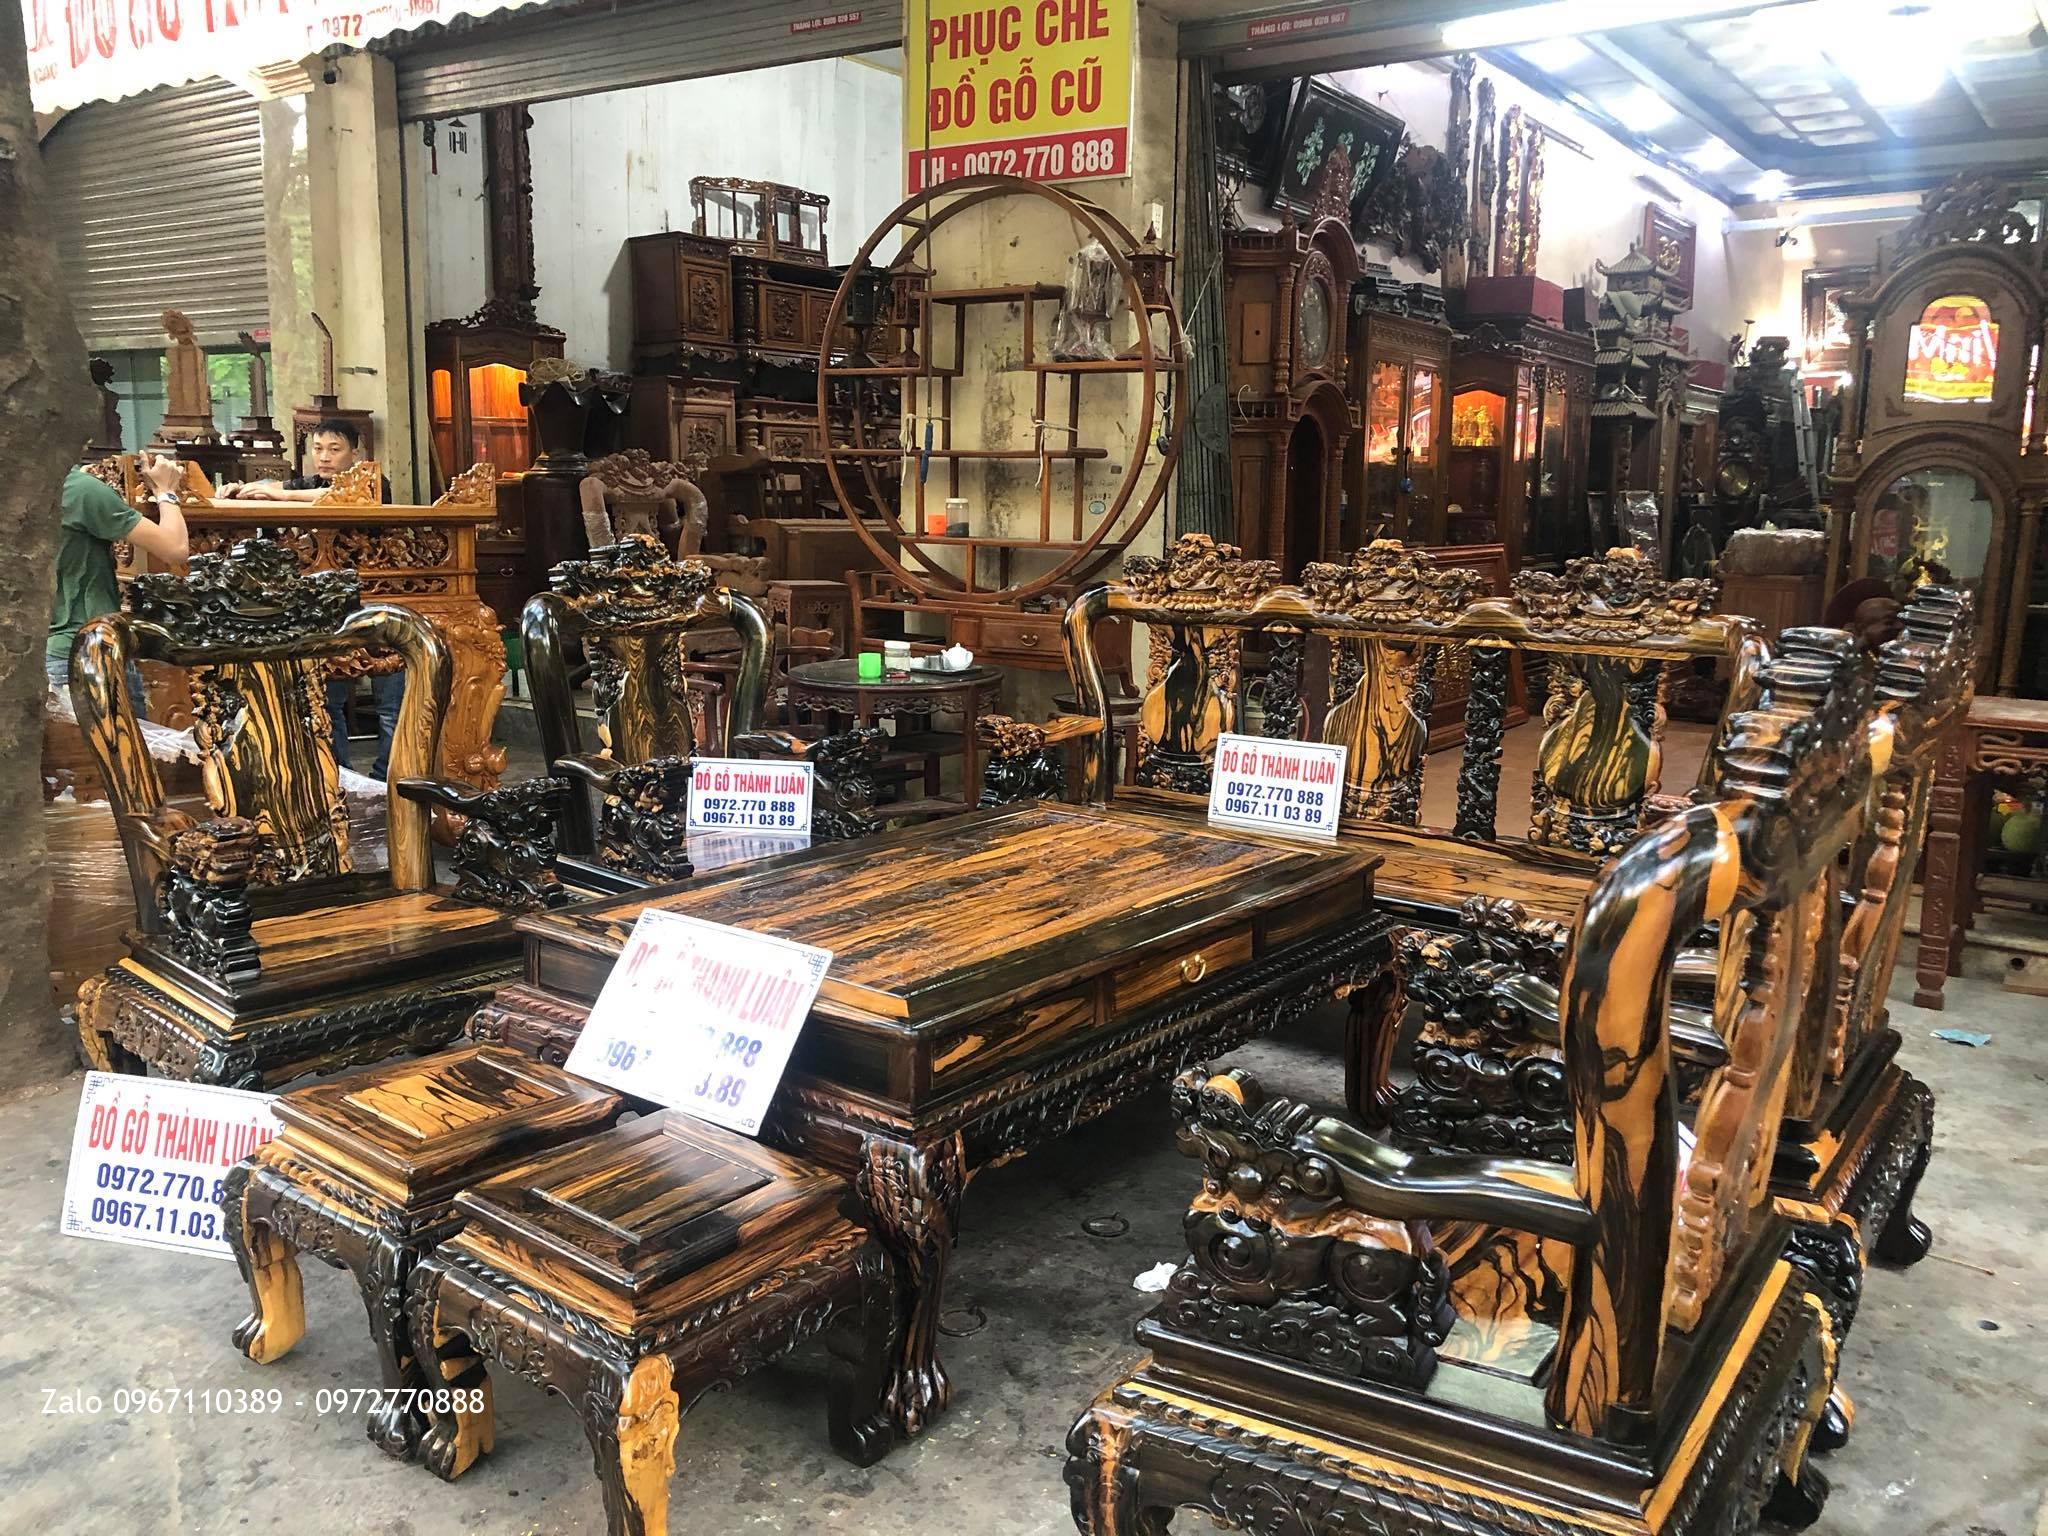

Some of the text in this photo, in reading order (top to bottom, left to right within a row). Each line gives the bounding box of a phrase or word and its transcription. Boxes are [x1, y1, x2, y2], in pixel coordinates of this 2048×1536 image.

[929, 6, 1022, 66] PHỤC
[930, 56, 1102, 132] ĐỒ GỖ CŨ
[1071, 138, 1114, 174] 888
[695, 766, 805, 795] ĐỒ GỖ THÀNH LUÂN
[1222, 744, 1336, 785] ĐỒ GỖ THÀNH LUÂN
[704, 798, 795, 813] 0972.770 888
[1225, 797, 1322, 823] 0967.11 03 89
[1227, 781, 1324, 806] 0972.770 888
[703, 811, 795, 827] 0967.11 03 89
[88, 1091, 121, 1151] ĐỒ
[121, 1094, 151, 1155] GỖ
[154, 1107, 219, 1164] THÀNH
[96, 1162, 225, 1205] 0972.770.8
[91, 1197, 228, 1242] 0967.11.03.
